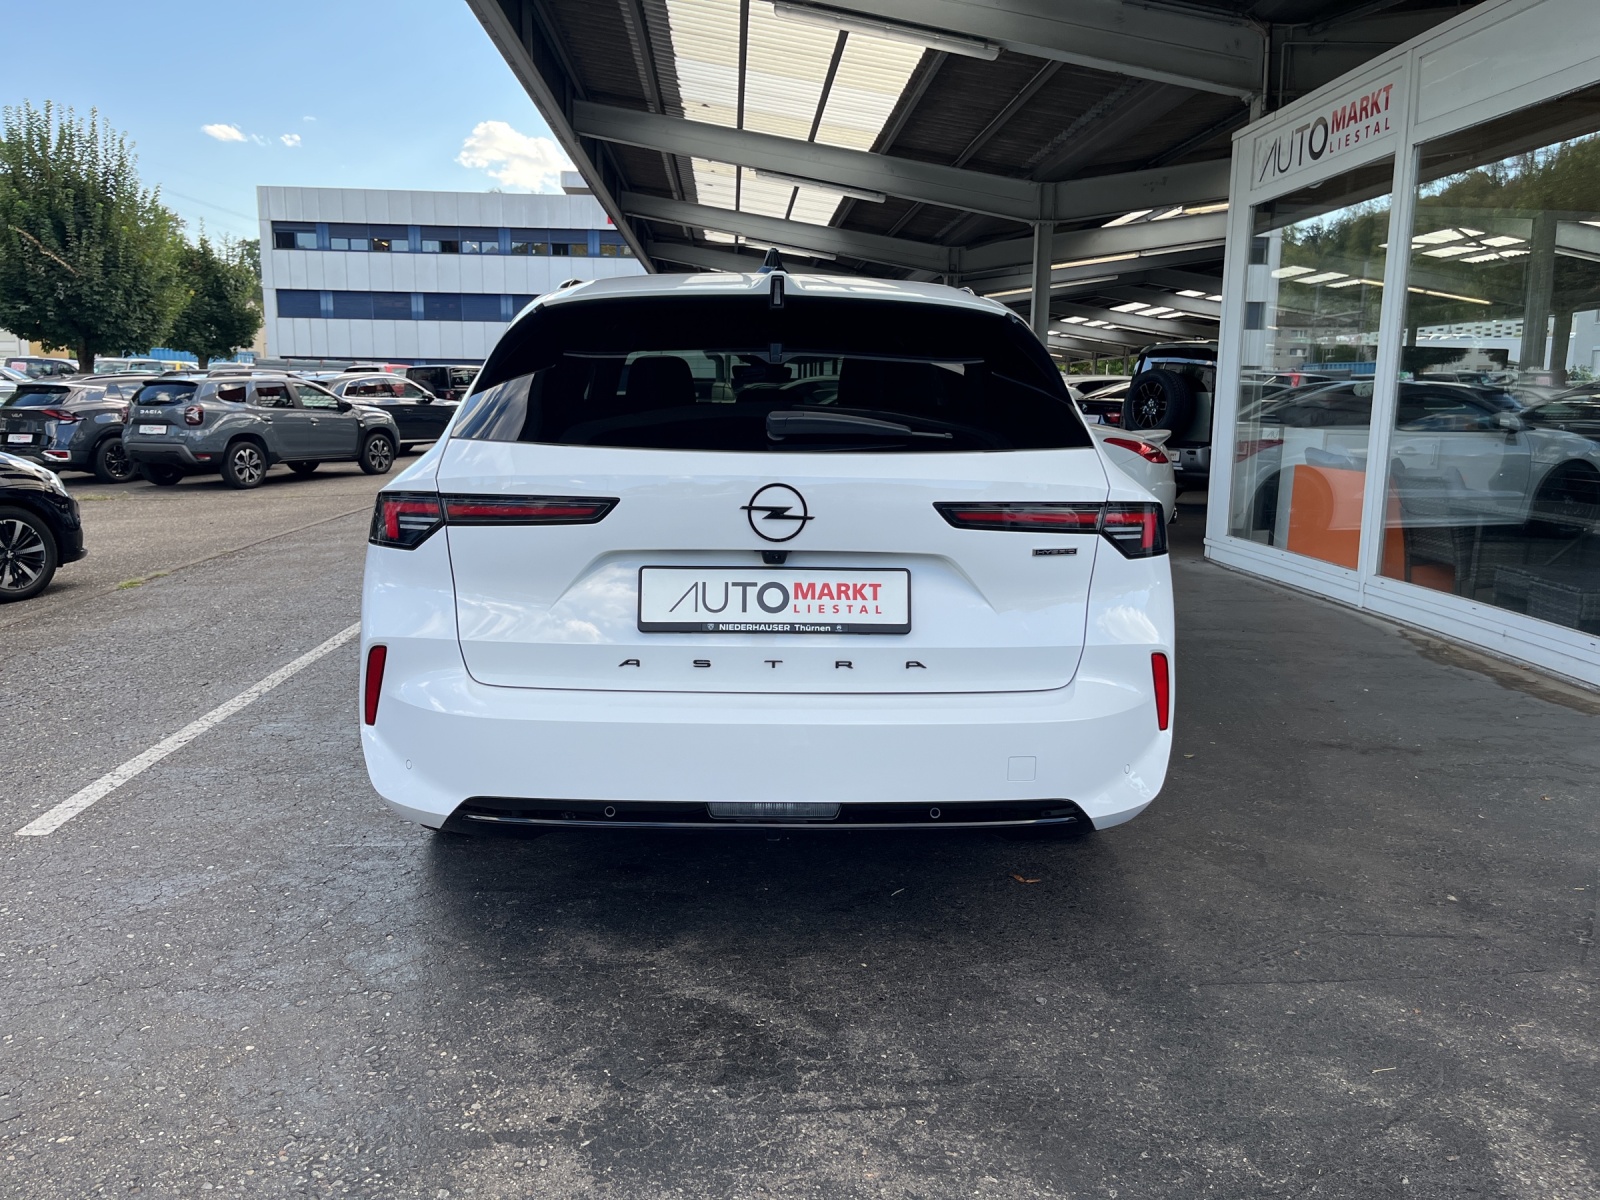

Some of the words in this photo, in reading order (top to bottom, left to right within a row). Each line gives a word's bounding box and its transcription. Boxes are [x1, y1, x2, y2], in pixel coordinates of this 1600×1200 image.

[1259, 116, 1329, 182] AUTO
[1330, 83, 1394, 135] MARKT
[1329, 117, 1390, 154] LIESTAL
[668, 581, 790, 614] AUTO
[793, 582, 882, 601] MARKT
[793, 604, 882, 615] LIESTAL
[718, 623, 791, 632] NIEDERHAUSER
[794, 623, 831, 632] Thürnen
[618, 658, 927, 669] ASTRA
